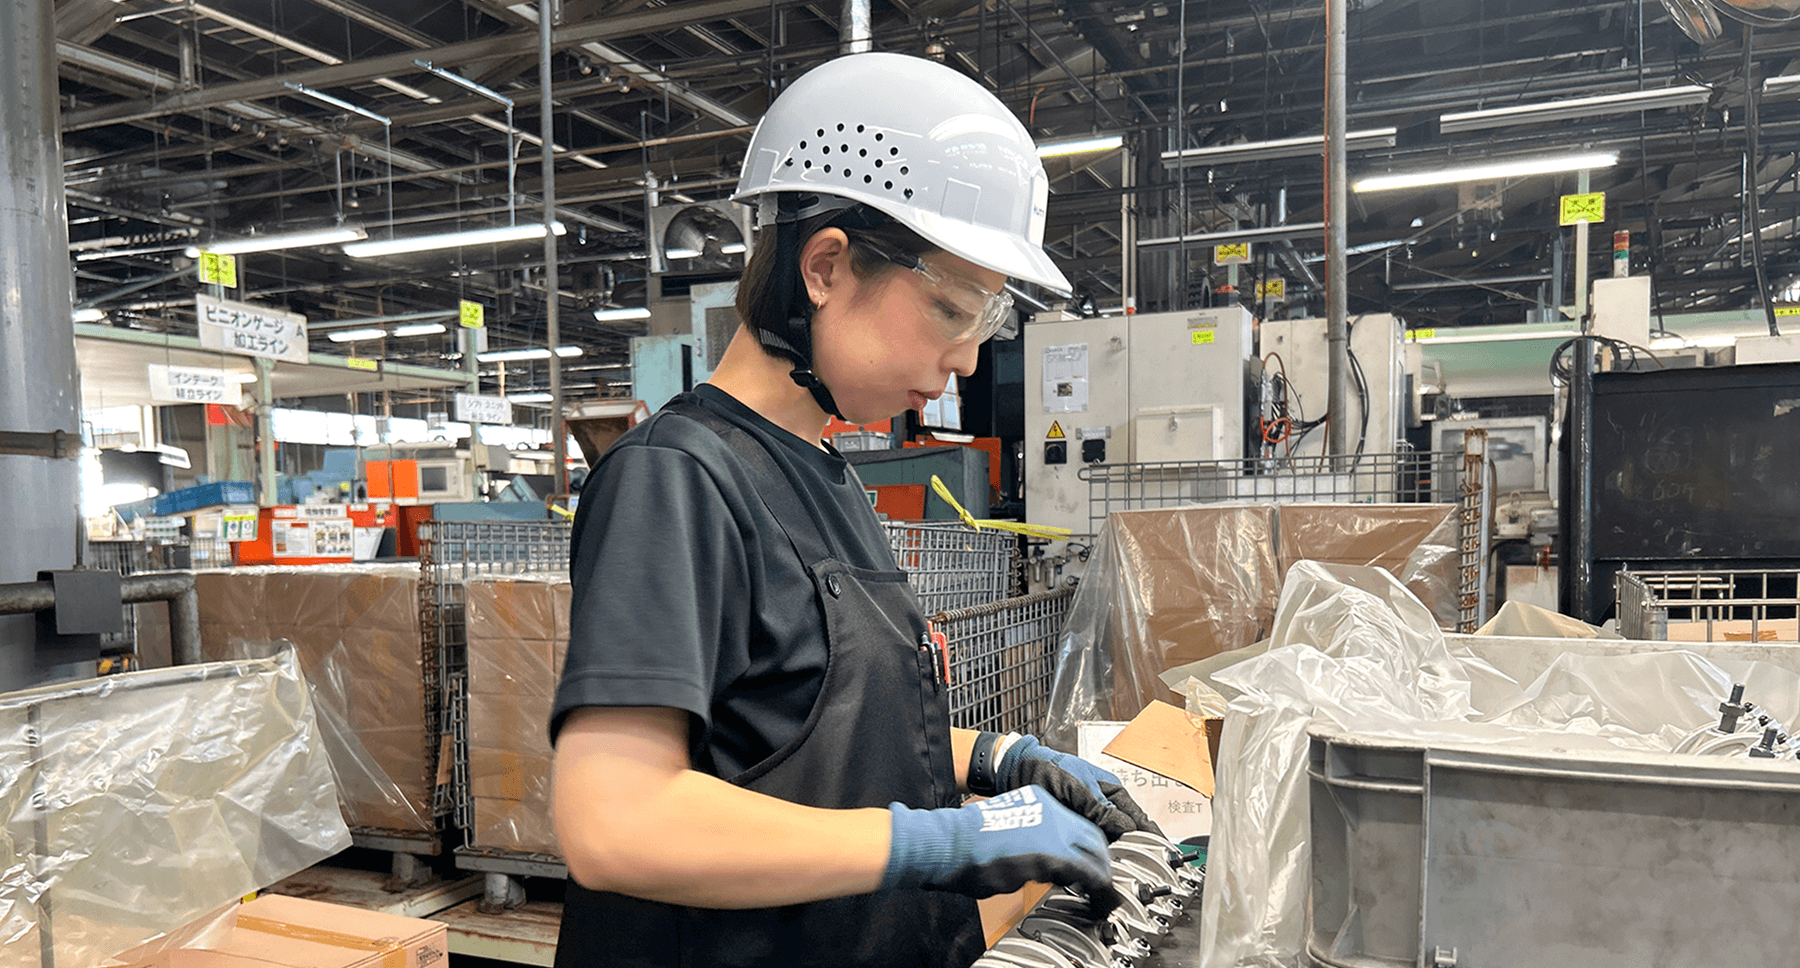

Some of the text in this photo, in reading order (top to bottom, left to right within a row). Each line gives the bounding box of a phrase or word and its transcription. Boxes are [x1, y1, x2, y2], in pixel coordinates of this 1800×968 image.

[295, 324, 305, 338] A
[234, 331, 289, 354] 加工ライン
